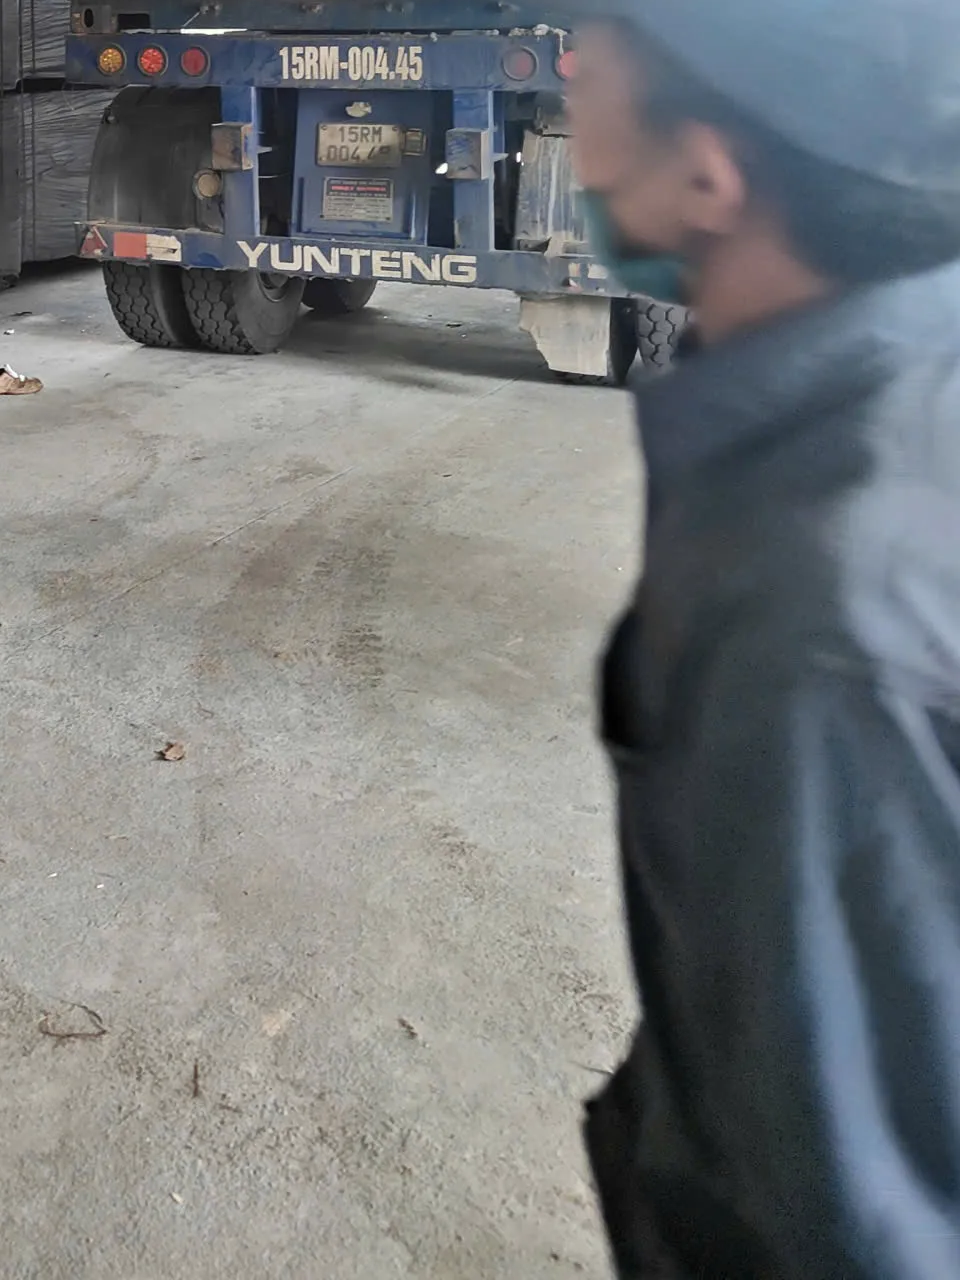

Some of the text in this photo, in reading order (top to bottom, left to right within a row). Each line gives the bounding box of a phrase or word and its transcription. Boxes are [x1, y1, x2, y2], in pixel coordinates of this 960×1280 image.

[279, 46, 423, 81] 15RM-004.45
[338, 126, 383, 142] 15RM
[236, 240, 477, 283] YUNTENG
